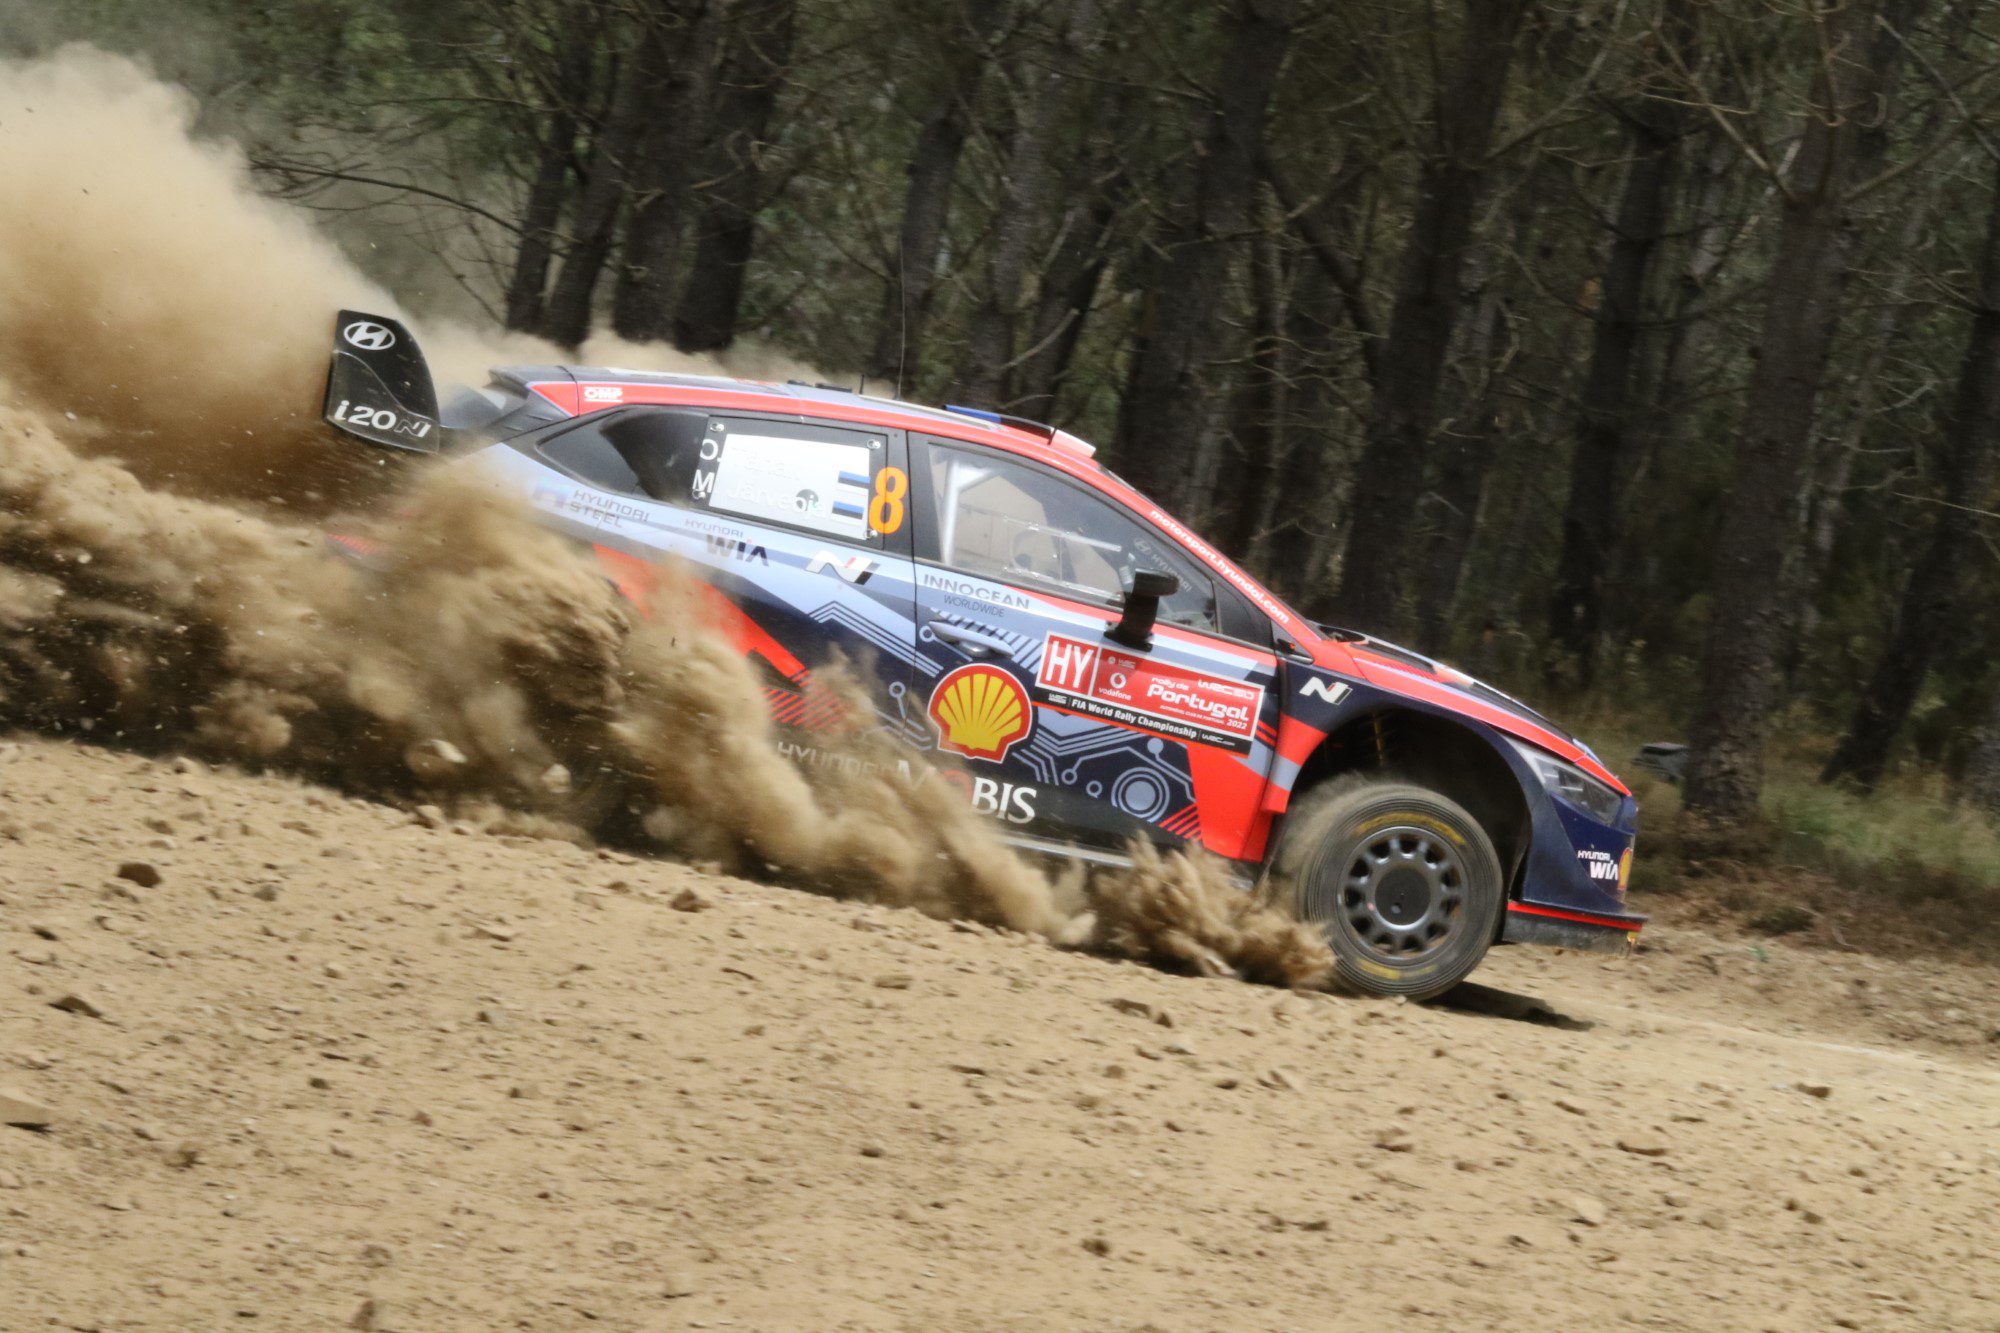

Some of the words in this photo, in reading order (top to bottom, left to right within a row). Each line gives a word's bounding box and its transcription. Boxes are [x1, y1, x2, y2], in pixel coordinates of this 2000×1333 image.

[569, 501, 623, 528] STEEL
[574, 489, 651, 523] HYUNDAI
[869, 466, 909, 536] 8
[685, 518, 744, 538] HYUNDAI
[706, 534, 770, 567] WIA
[1150, 510, 1290, 625] motorsport.hyundai.com
[923, 573, 1030, 610] INNOCEAN
[944, 594, 1005, 618] WORLDWIDE
[1045, 640, 1095, 689] HY
[1098, 687, 1132, 701] vodafone
[1151, 677, 1176, 689] rally
[1175, 681, 1190, 691] de
[1147, 684, 1250, 722] Portugal
[1071, 698, 1087, 711] FIA
[1088, 702, 1113, 717] World
[1114, 709, 1136, 724] Rally
[1137, 715, 1197, 740] Championship
[1226, 718, 1248, 731] 2022
[1577, 850, 1611, 861] HYUNDAI
[1589, 860, 1619, 881] WIA
